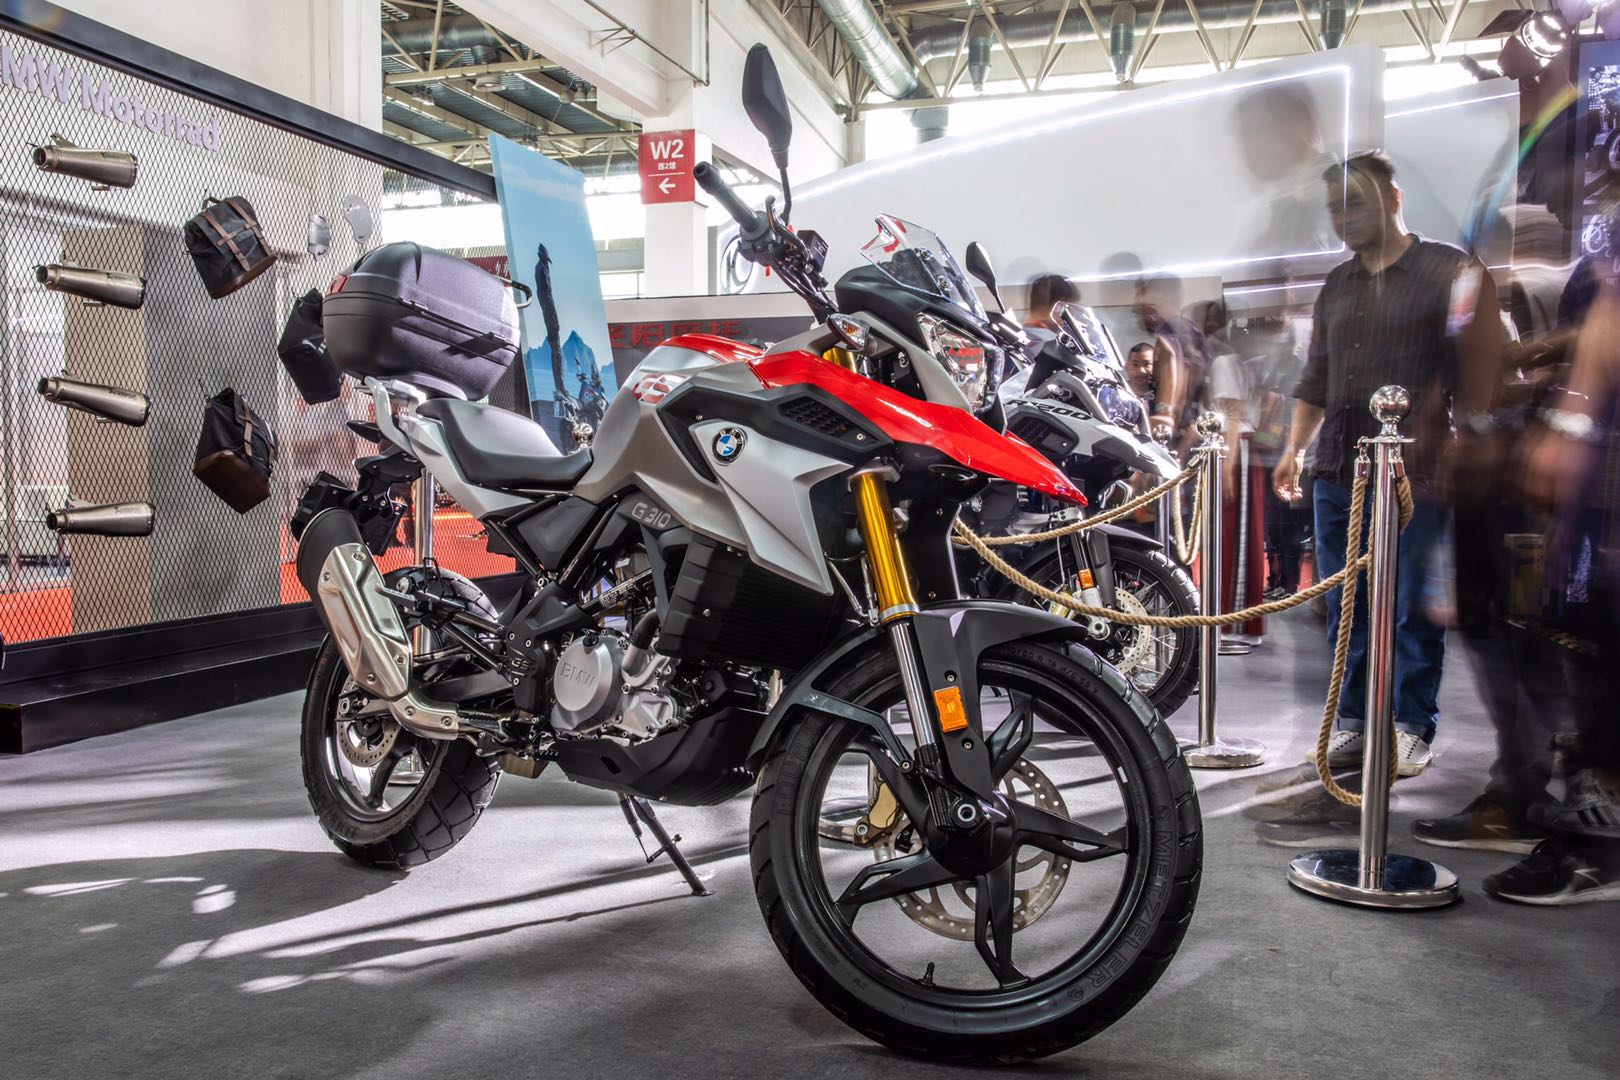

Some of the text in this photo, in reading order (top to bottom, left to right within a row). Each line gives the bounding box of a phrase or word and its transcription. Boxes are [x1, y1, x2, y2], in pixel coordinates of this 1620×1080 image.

[1, 45, 219, 152] MW Motorrad
[649, 138, 685, 161] W2
[511, 657, 530, 670] GS
[1088, 829, 1174, 989] METZELER
